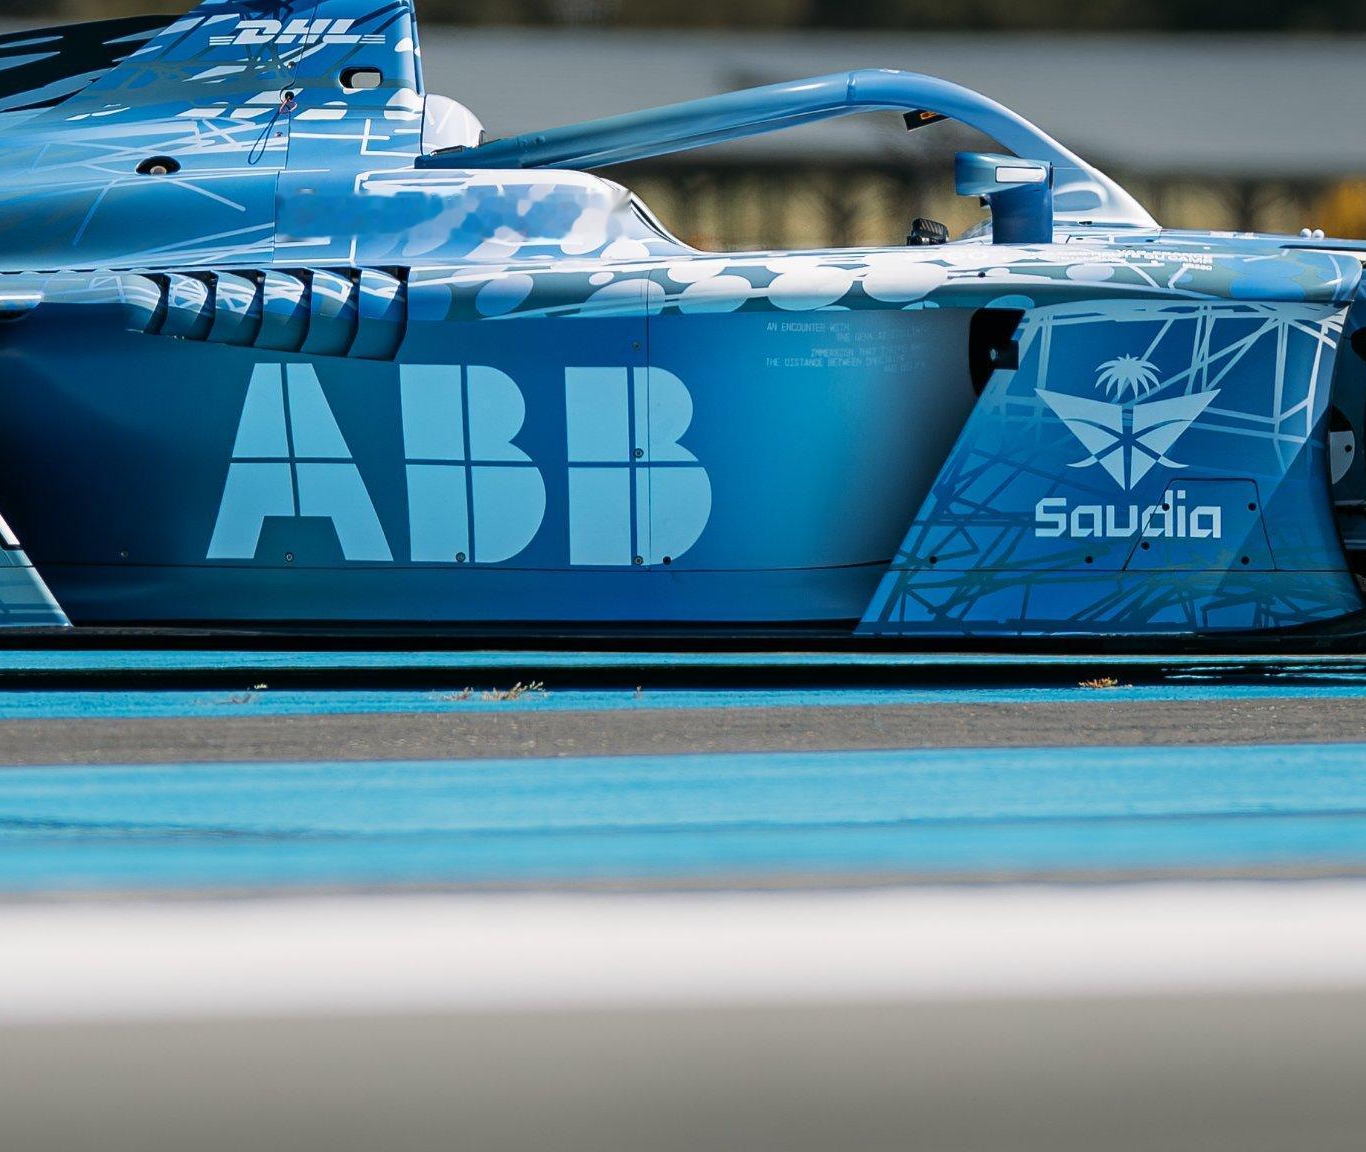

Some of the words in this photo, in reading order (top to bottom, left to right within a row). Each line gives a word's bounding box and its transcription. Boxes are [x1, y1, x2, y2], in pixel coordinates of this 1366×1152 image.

[233, 19, 362, 45] DHL
[766, 322, 777, 332] AN
[766, 358, 781, 367] THE
[206, 363, 712, 566] ABB
[1034, 491, 1222, 540] Saudia
